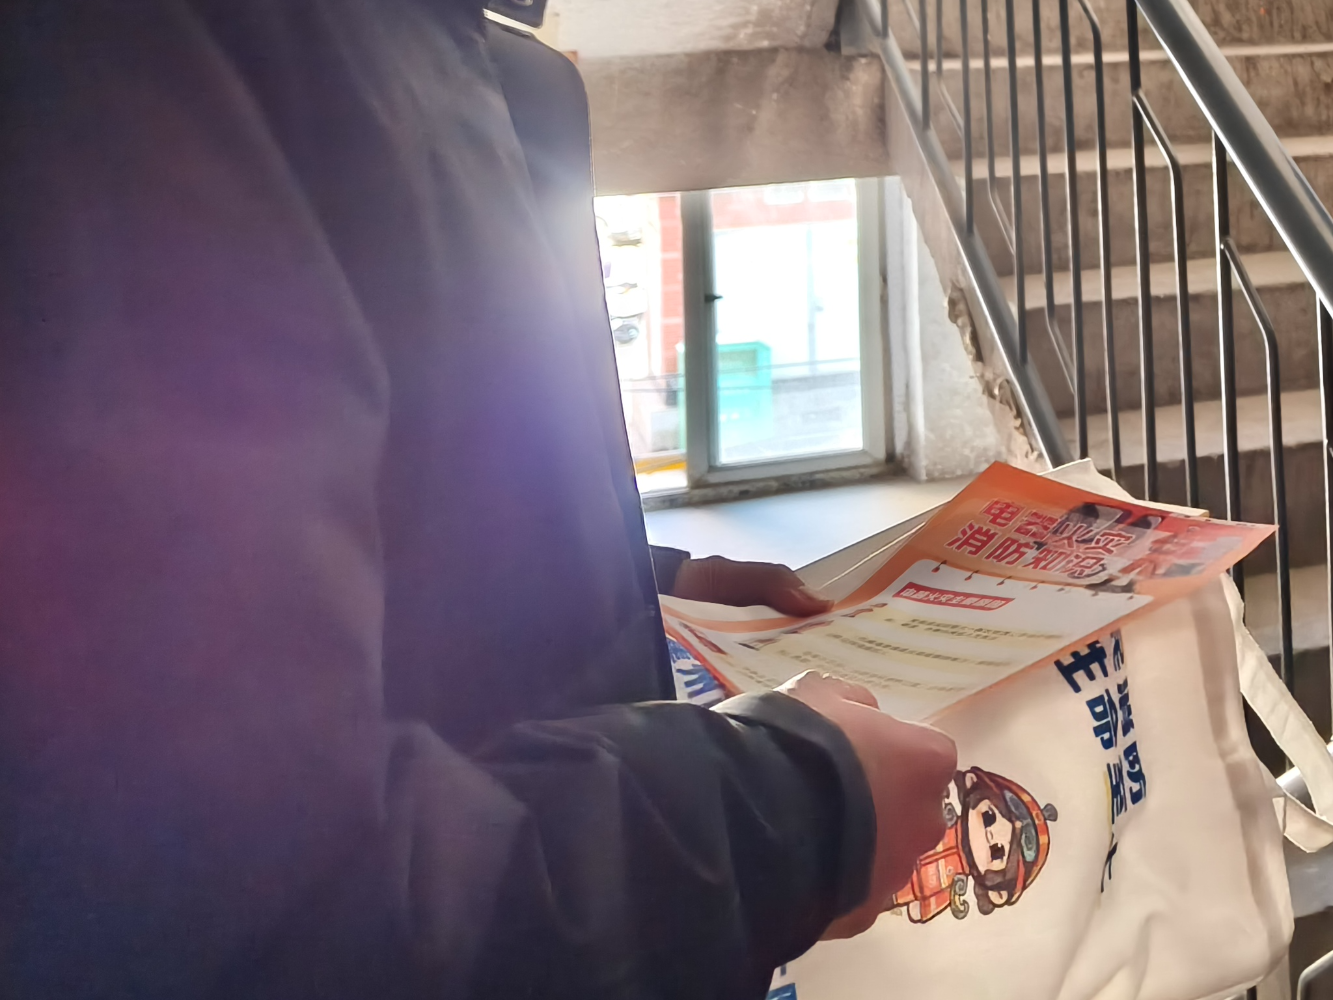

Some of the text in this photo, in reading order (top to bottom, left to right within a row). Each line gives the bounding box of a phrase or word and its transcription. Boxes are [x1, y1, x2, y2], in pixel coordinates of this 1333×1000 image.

[946, 521, 1106, 578] 消防知识
[979, 498, 1136, 556] 电器火灾
